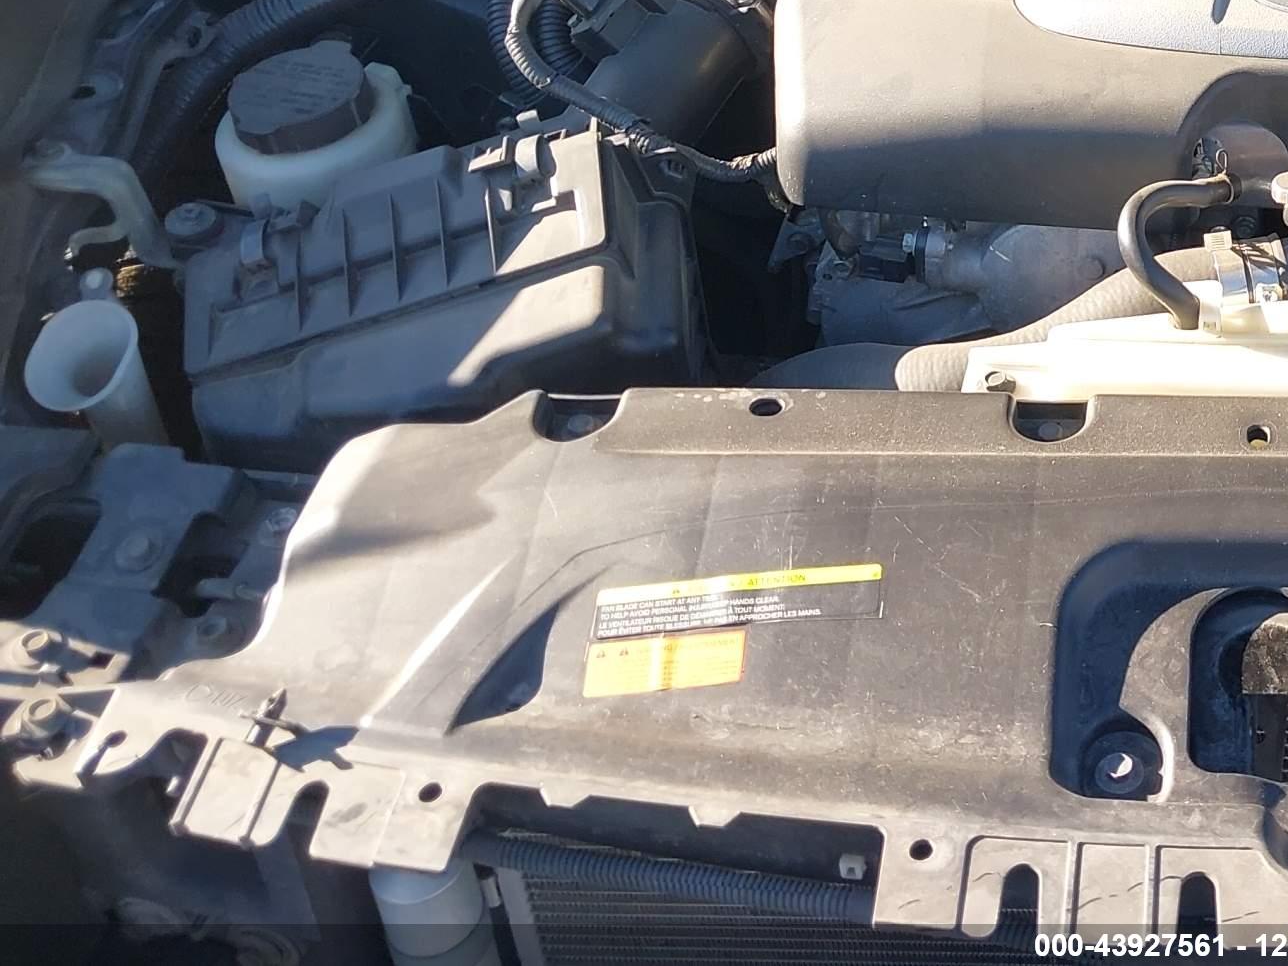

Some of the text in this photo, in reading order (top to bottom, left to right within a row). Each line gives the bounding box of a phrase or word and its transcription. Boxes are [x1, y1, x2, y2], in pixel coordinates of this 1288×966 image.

[747, 574, 806, 586] ATTENTION
[608, 617, 652, 628] VENTILATEUR
[653, 614, 678, 624] RISQUE
[735, 605, 753, 614] TOUT
[611, 611, 629, 619] HELP
[630, 609, 650, 618] AVOID
[651, 605, 687, 617] PERSONAL
[729, 598, 754, 606] HANDS
[616, 602, 638, 611] BLADE
[598, 628, 618, 637] POUR
[618, 625, 642, 636] ÉVITER
[740, 611, 783, 621] APPROCHER
